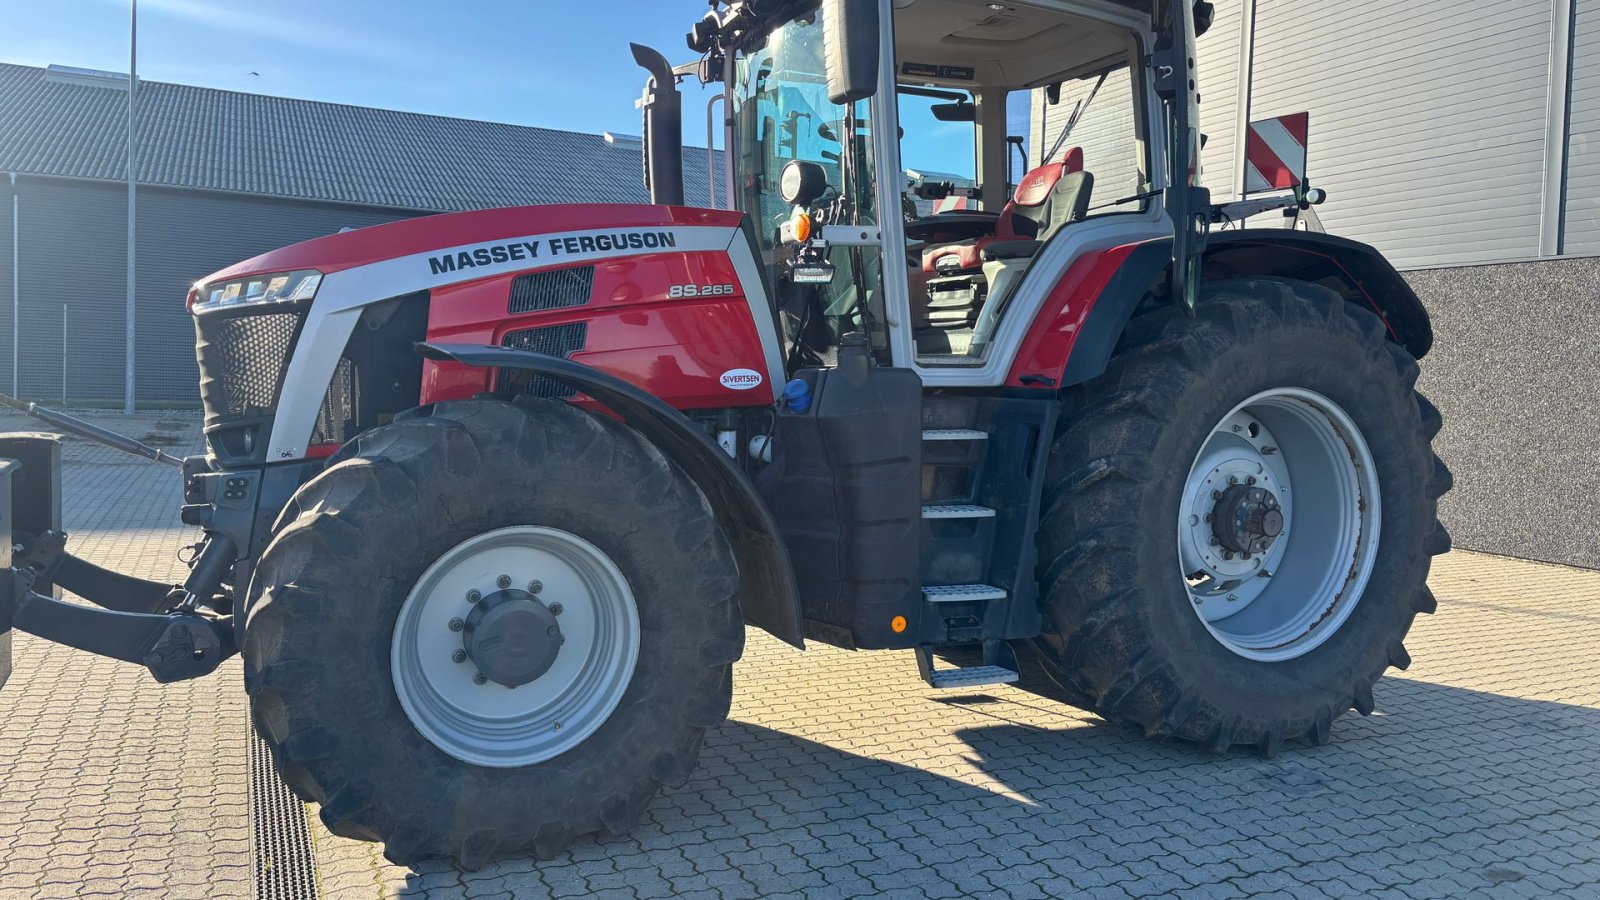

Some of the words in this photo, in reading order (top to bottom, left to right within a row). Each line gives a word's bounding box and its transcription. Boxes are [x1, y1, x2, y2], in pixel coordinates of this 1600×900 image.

[428, 241, 539, 275] MASSEY
[548, 232, 676, 255] FERGUSON
[669, 284, 734, 298] 8S.265
[722, 375, 760, 383] SIVERTSEN
